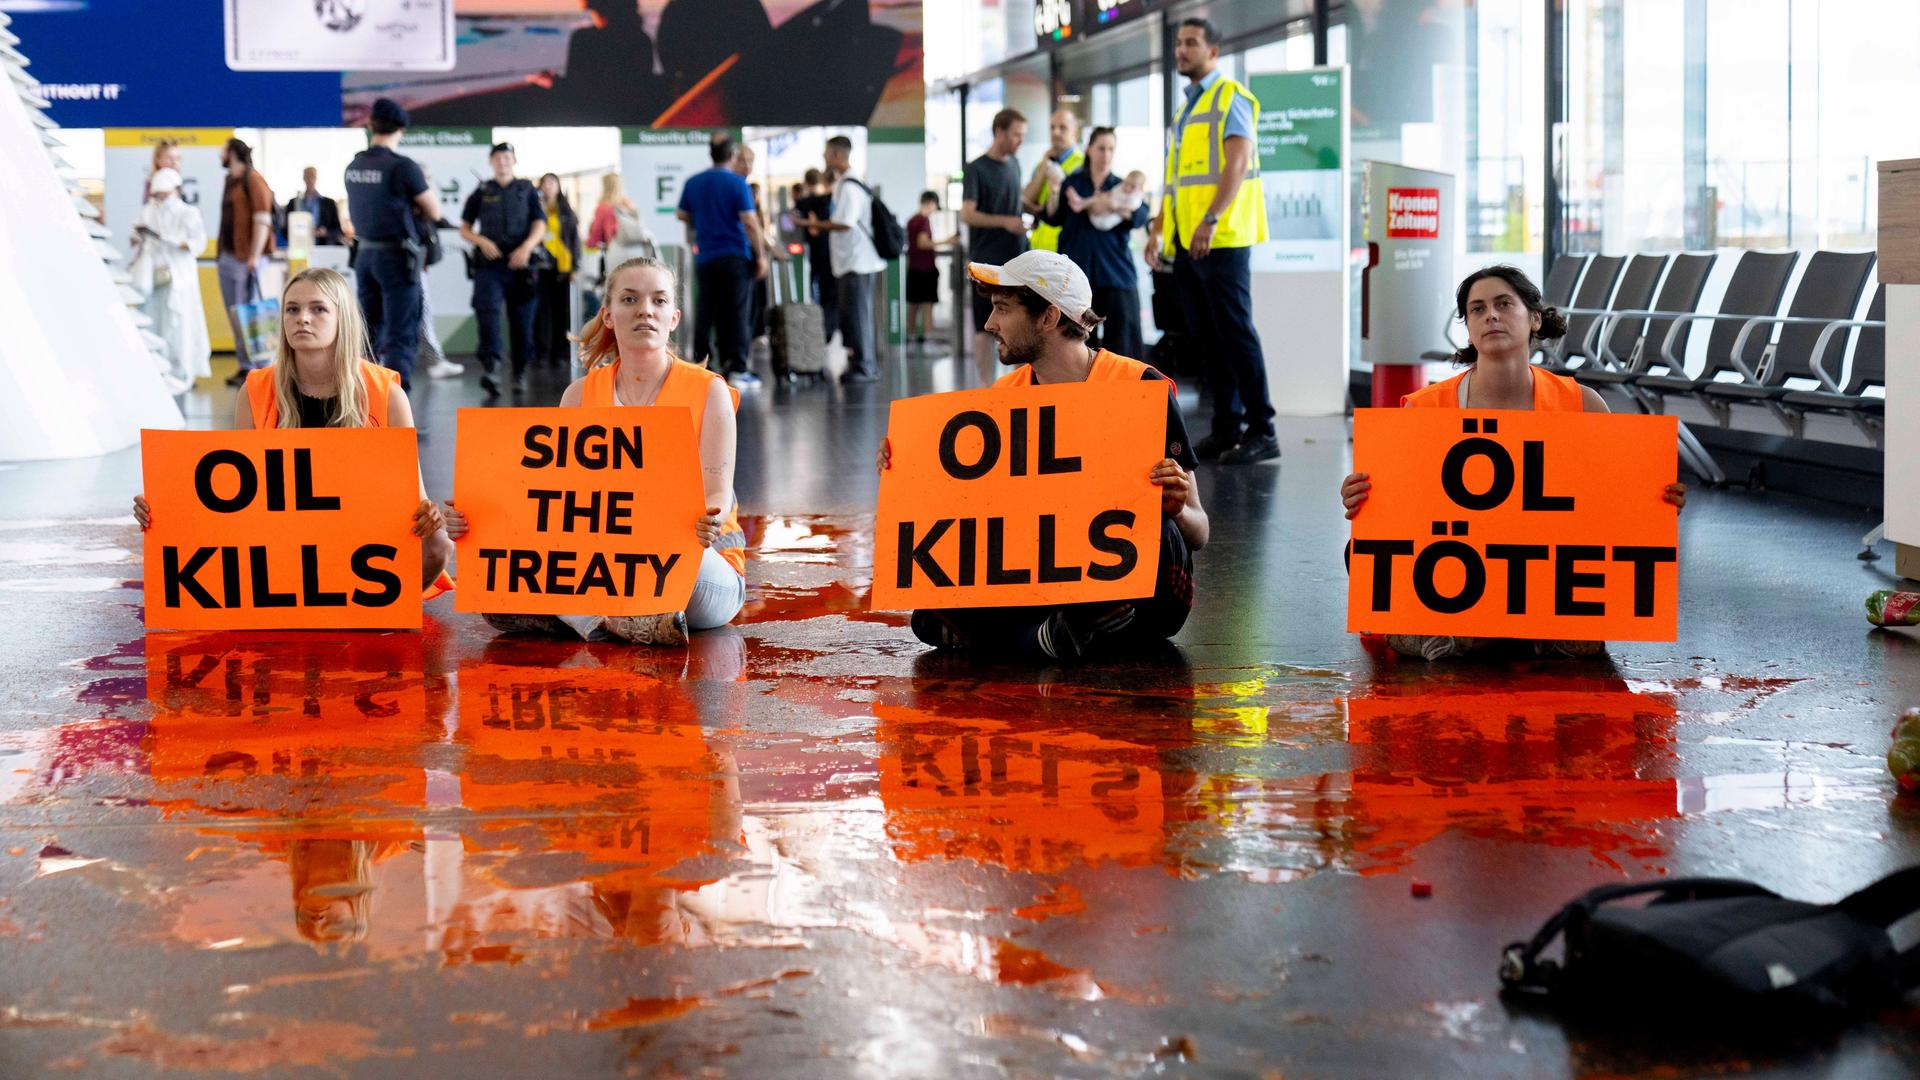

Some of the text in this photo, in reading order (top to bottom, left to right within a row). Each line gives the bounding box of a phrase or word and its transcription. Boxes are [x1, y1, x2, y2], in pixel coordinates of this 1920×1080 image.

[31, 83, 119, 100] ITHOUT IT
[399, 130, 474, 145] curity Check
[638, 130, 711, 144] Security Che
[345, 169, 382, 184] POLIZEI
[657, 175, 674, 201] F
[1389, 192, 1438, 211] Kronen
[1389, 209, 1437, 233] Zeitung
[521, 424, 643, 470] SIGN
[938, 405, 1082, 481] OIL
[1441, 418, 1575, 512] ÖL
[195, 449, 341, 514] OIL
[527, 490, 634, 534] THE
[896, 509, 1138, 589] KILLS
[1353, 520, 1677, 617] TÖTET
[162, 543, 402, 609] KILLS
[479, 549, 682, 598] TREATY
